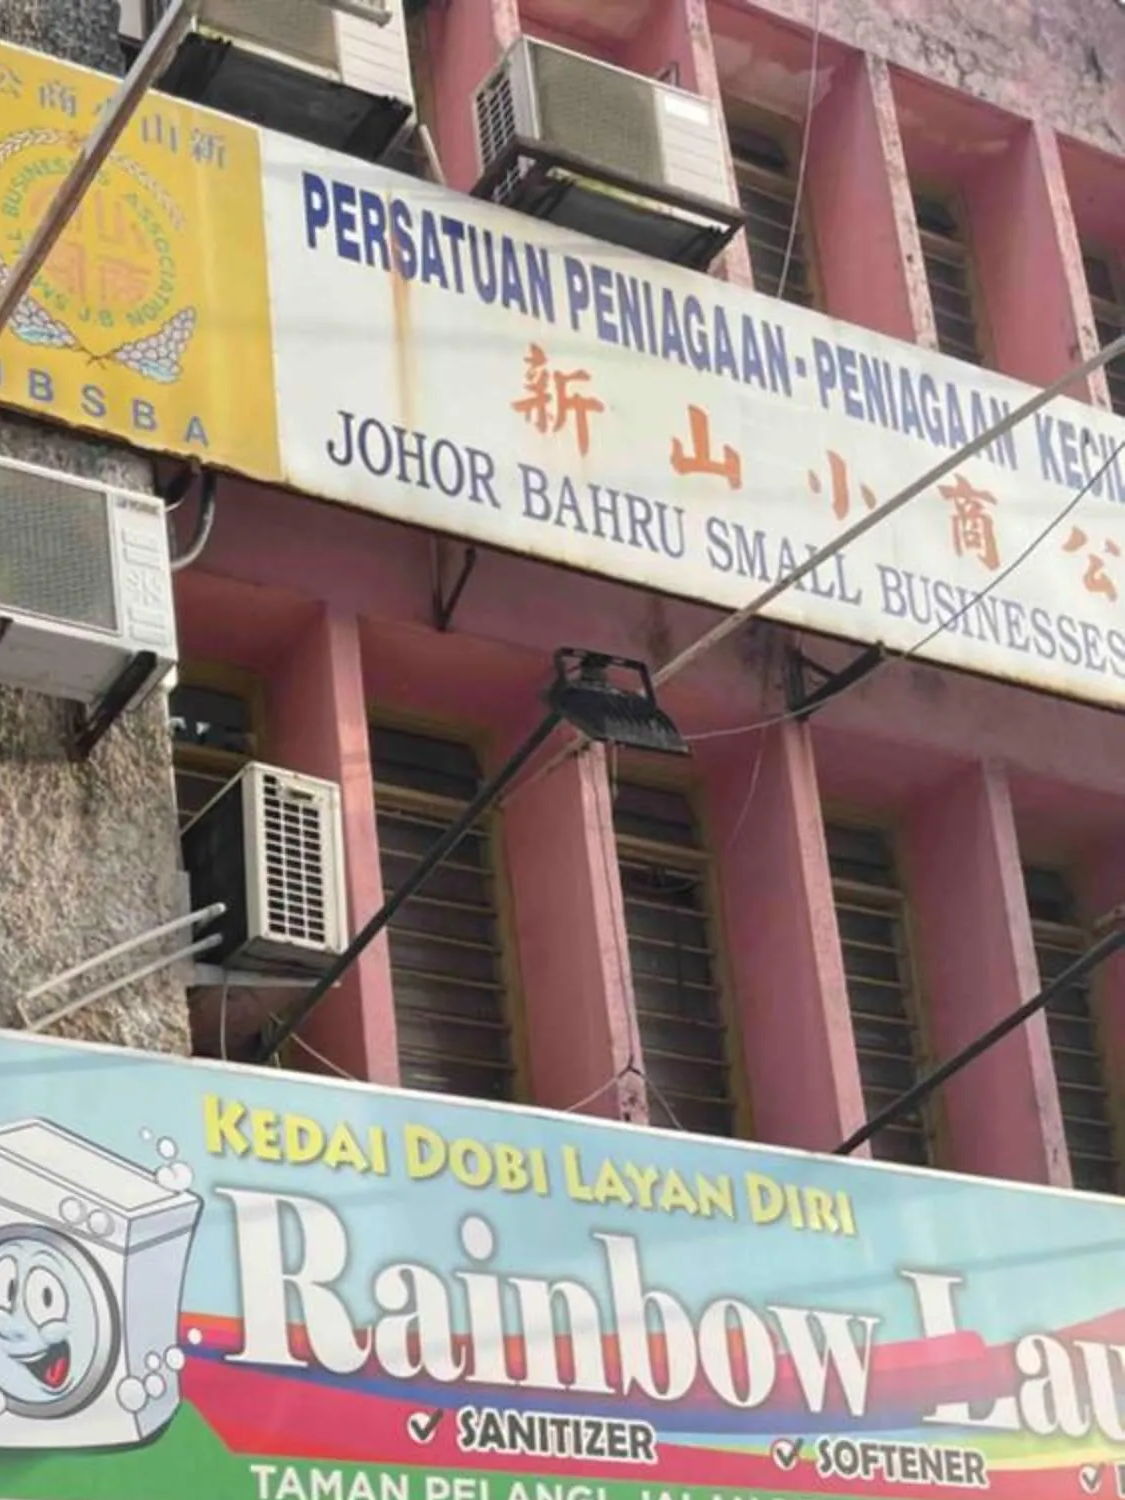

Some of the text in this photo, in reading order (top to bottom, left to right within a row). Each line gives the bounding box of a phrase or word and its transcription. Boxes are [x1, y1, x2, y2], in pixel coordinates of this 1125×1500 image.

[301, 171, 556, 324] PERSATUAN
[327, 411, 1125, 681] JOHOR BAHRU SMALL BUSINESSES
[201, 1092, 858, 1237] KEDAI DOBI LAYAN DIRI
[214, 1186, 881, 1417] Rainbow
[458, 1407, 656, 1462] SANITIZER
[817, 1437, 988, 1487] SOFTENER
